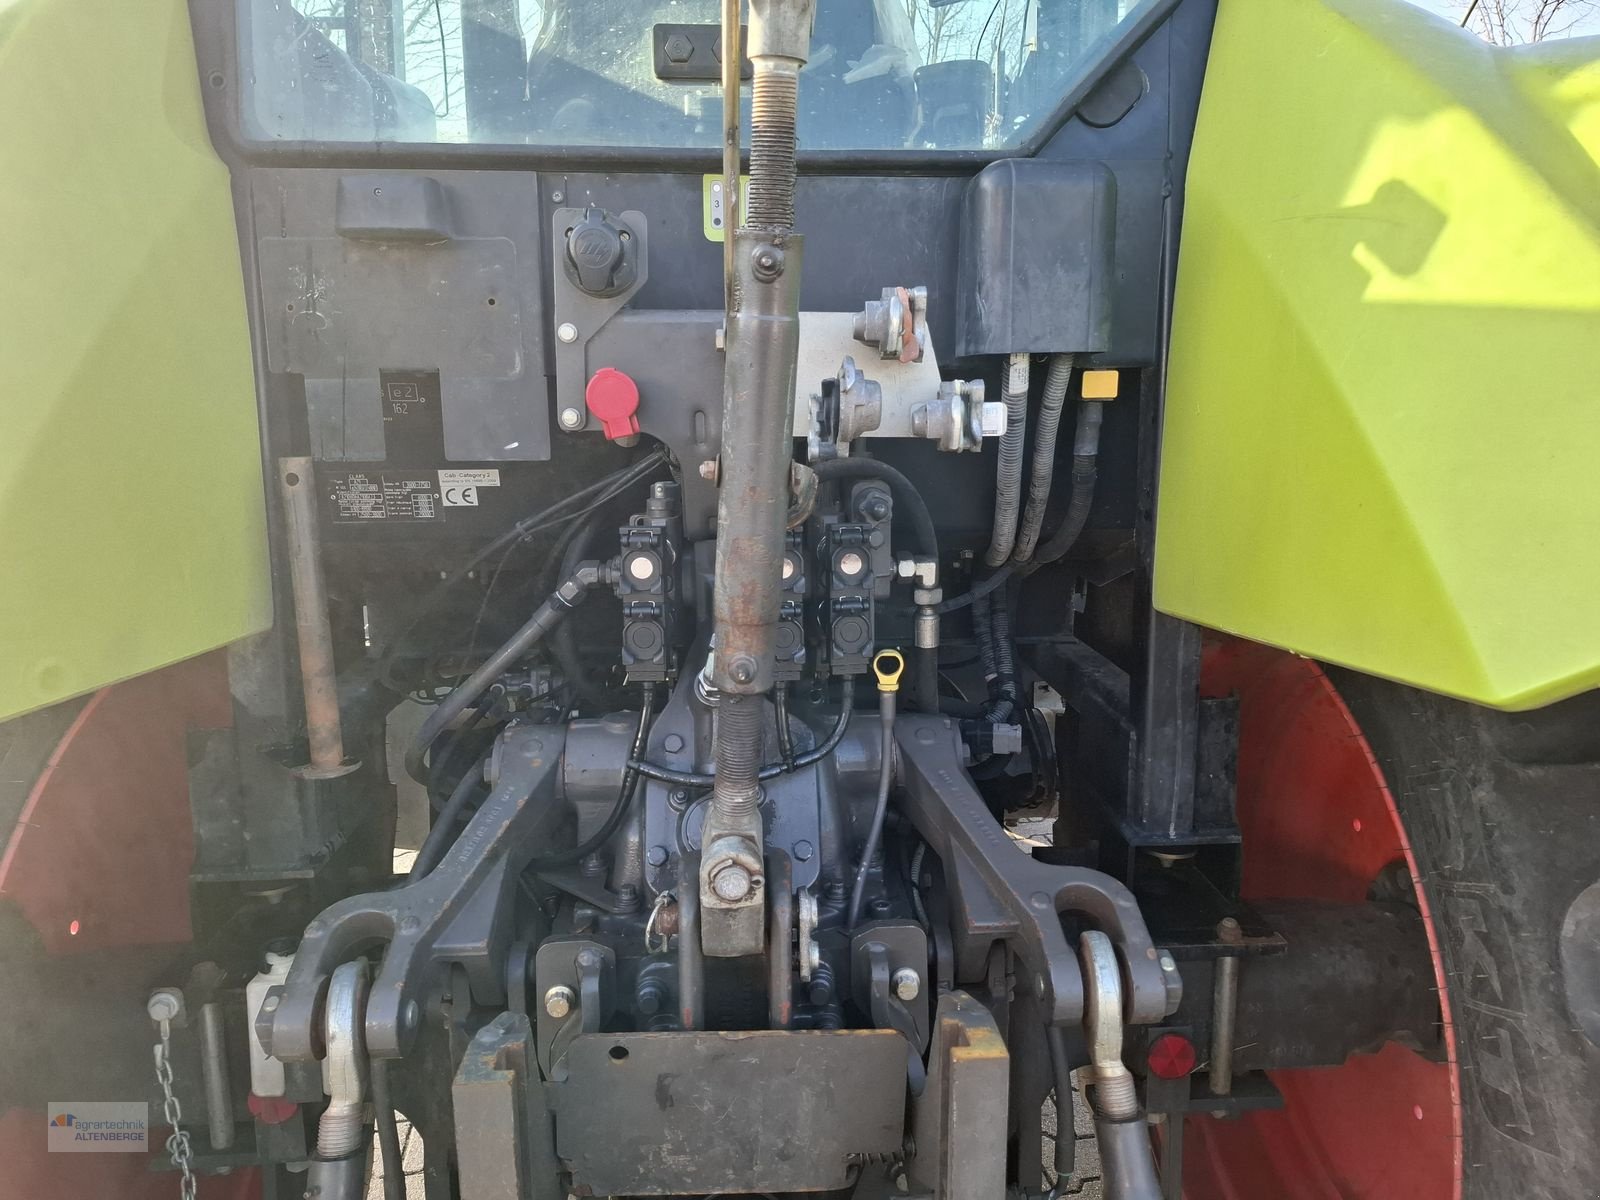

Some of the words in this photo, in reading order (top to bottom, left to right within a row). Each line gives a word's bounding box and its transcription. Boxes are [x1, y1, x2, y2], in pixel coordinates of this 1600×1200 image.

[714, 199, 720, 208] 3
[392, 402, 409, 415] 162
[445, 487, 474, 505] CE
